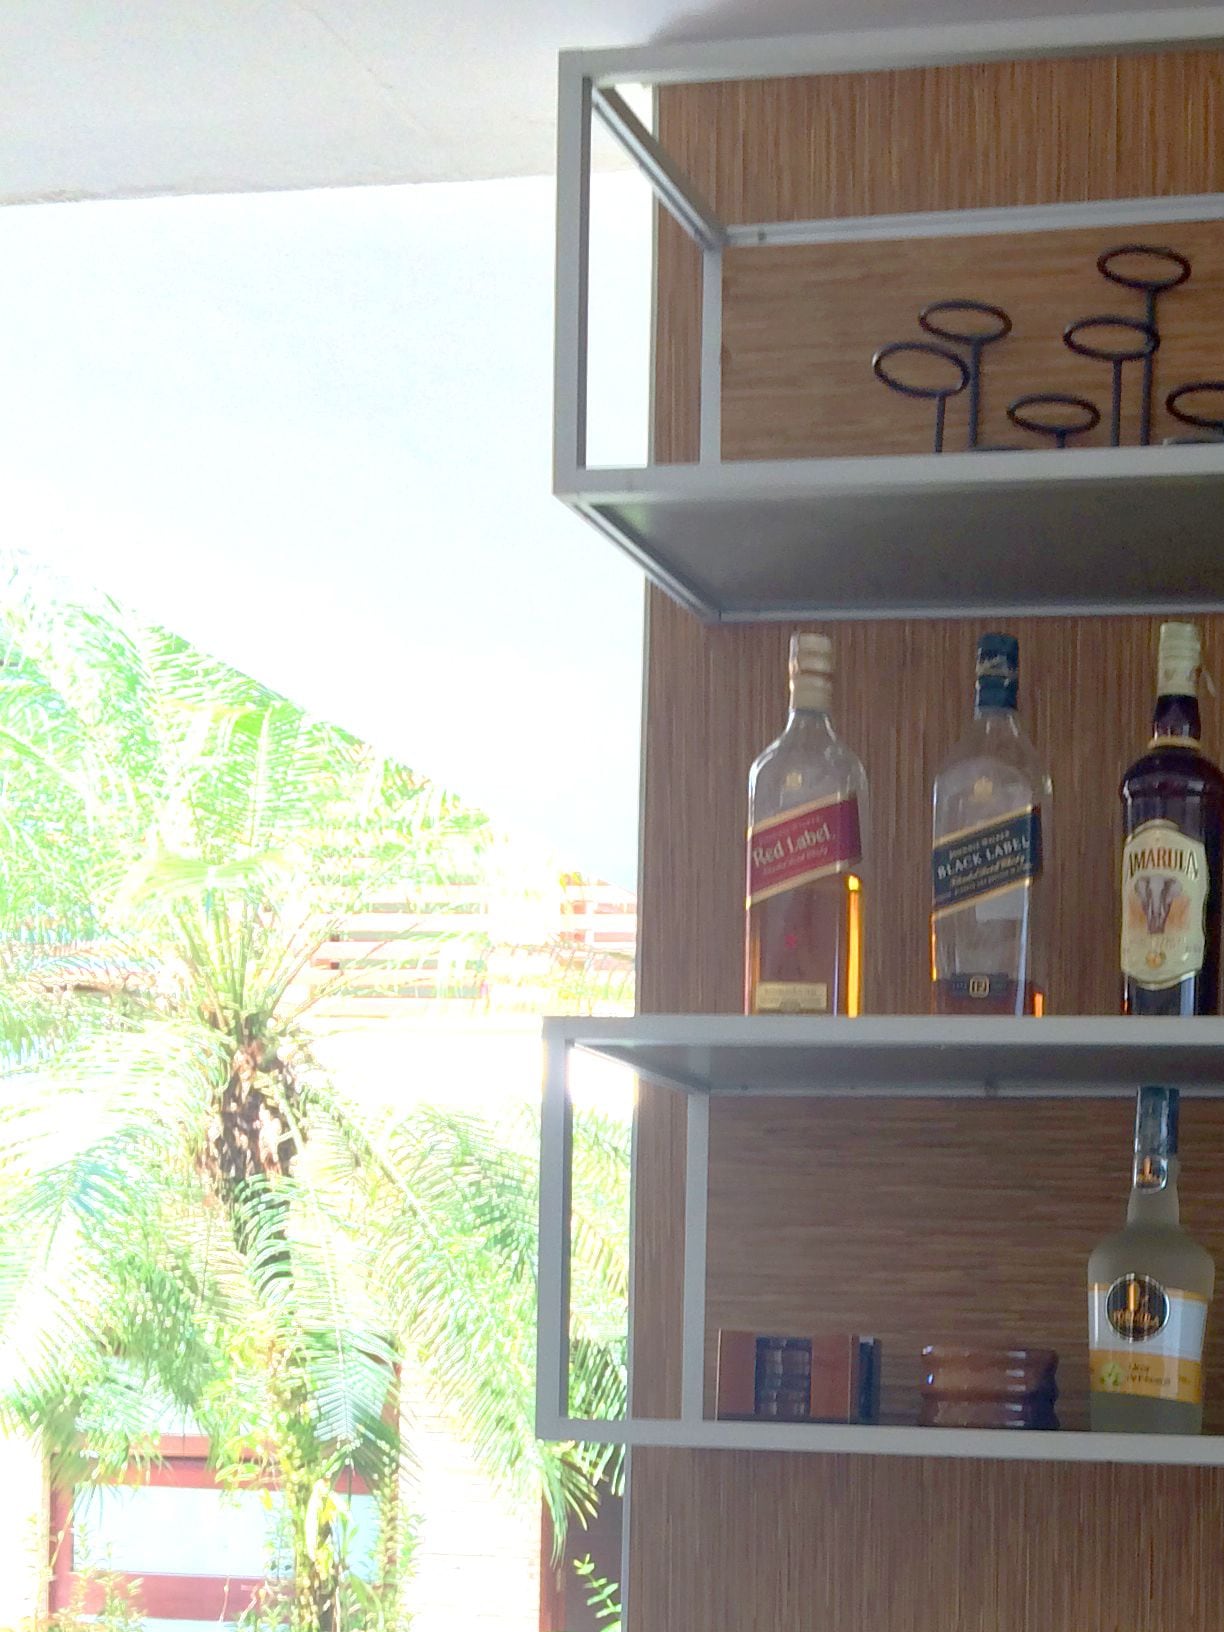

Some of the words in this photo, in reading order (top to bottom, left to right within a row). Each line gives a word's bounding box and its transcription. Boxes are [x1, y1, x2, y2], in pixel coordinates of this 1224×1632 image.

[753, 840, 785, 868] Red
[786, 821, 831, 854] Label
[937, 852, 982, 881] BLACK
[985, 834, 1031, 862] LABEL
[1128, 848, 1199, 881] AMARULA
